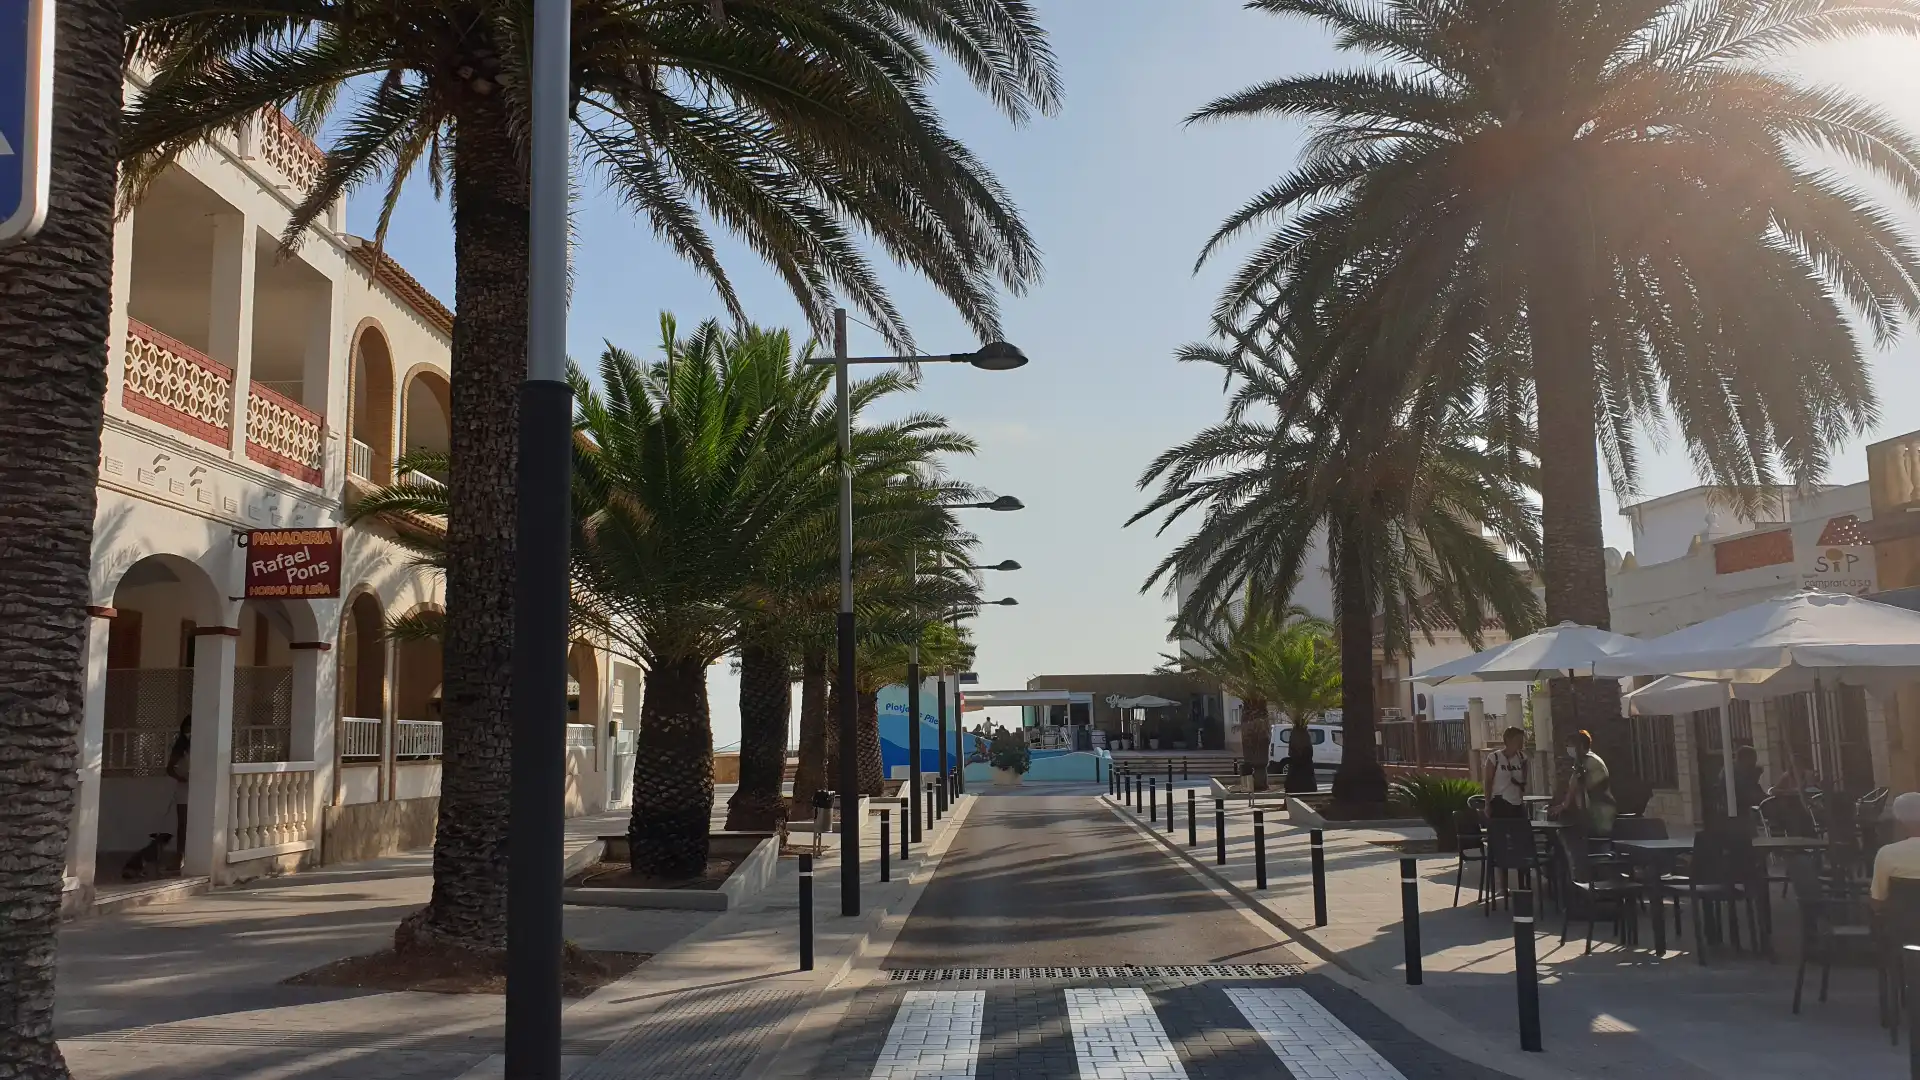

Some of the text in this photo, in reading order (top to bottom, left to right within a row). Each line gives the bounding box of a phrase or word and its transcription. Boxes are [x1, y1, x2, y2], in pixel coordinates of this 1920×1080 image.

[252, 530, 332, 546] PANADERIA
[252, 545, 311, 576] Rafael
[286, 561, 330, 583] Pons
[249, 585, 288, 596] HORNO
[289, 585, 304, 595] DE
